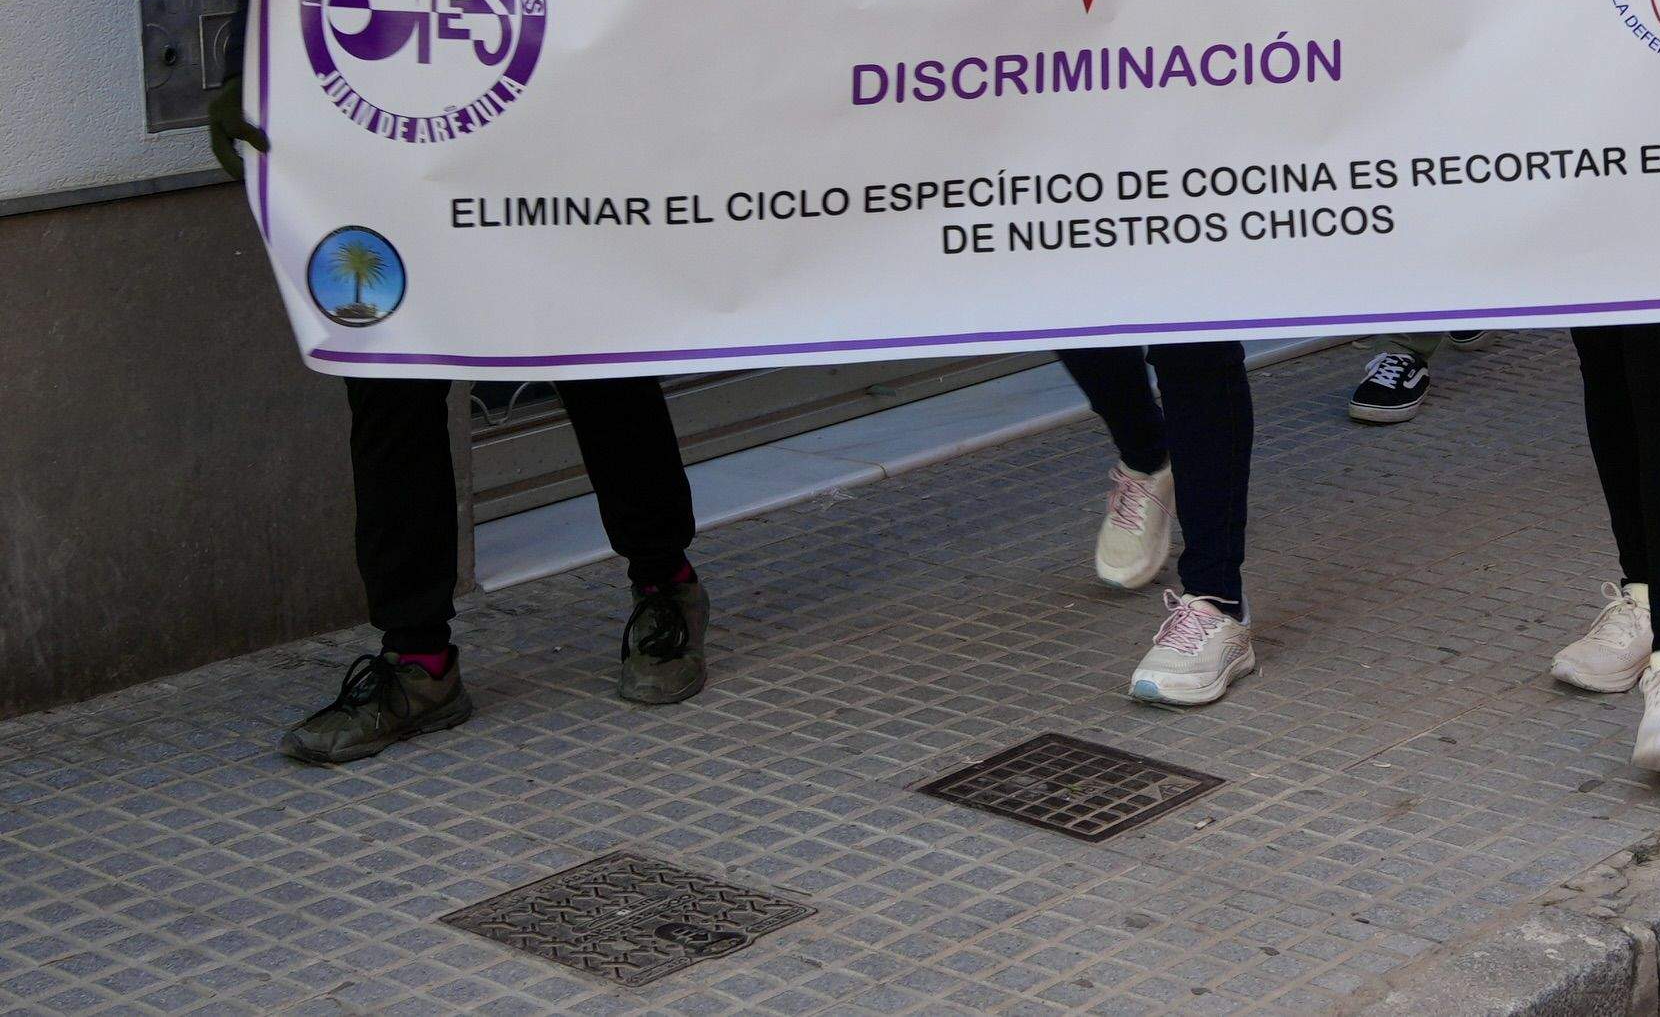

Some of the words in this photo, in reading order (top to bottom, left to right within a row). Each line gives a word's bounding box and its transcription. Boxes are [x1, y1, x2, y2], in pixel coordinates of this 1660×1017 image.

[852, 31, 1342, 105] DISCRIMINACIÓN
[317, 69, 379, 134] JUAN
[377, 109, 410, 142] DE
[451, 195, 652, 228] ELIMINAR
[665, 194, 714, 225] EL
[726, 187, 850, 221] CICLO
[863, 169, 1103, 213] ESPECÍFICO
[1117, 170, 1170, 200] DE
[1181, 162, 1337, 198] COCINA
[1349, 158, 1398, 189] ES
[1411, 147, 1628, 186] RECORTAR
[943, 222, 996, 254] DE
[1009, 211, 1228, 252] NUESTROS
[1240, 204, 1395, 241] CHICOS
